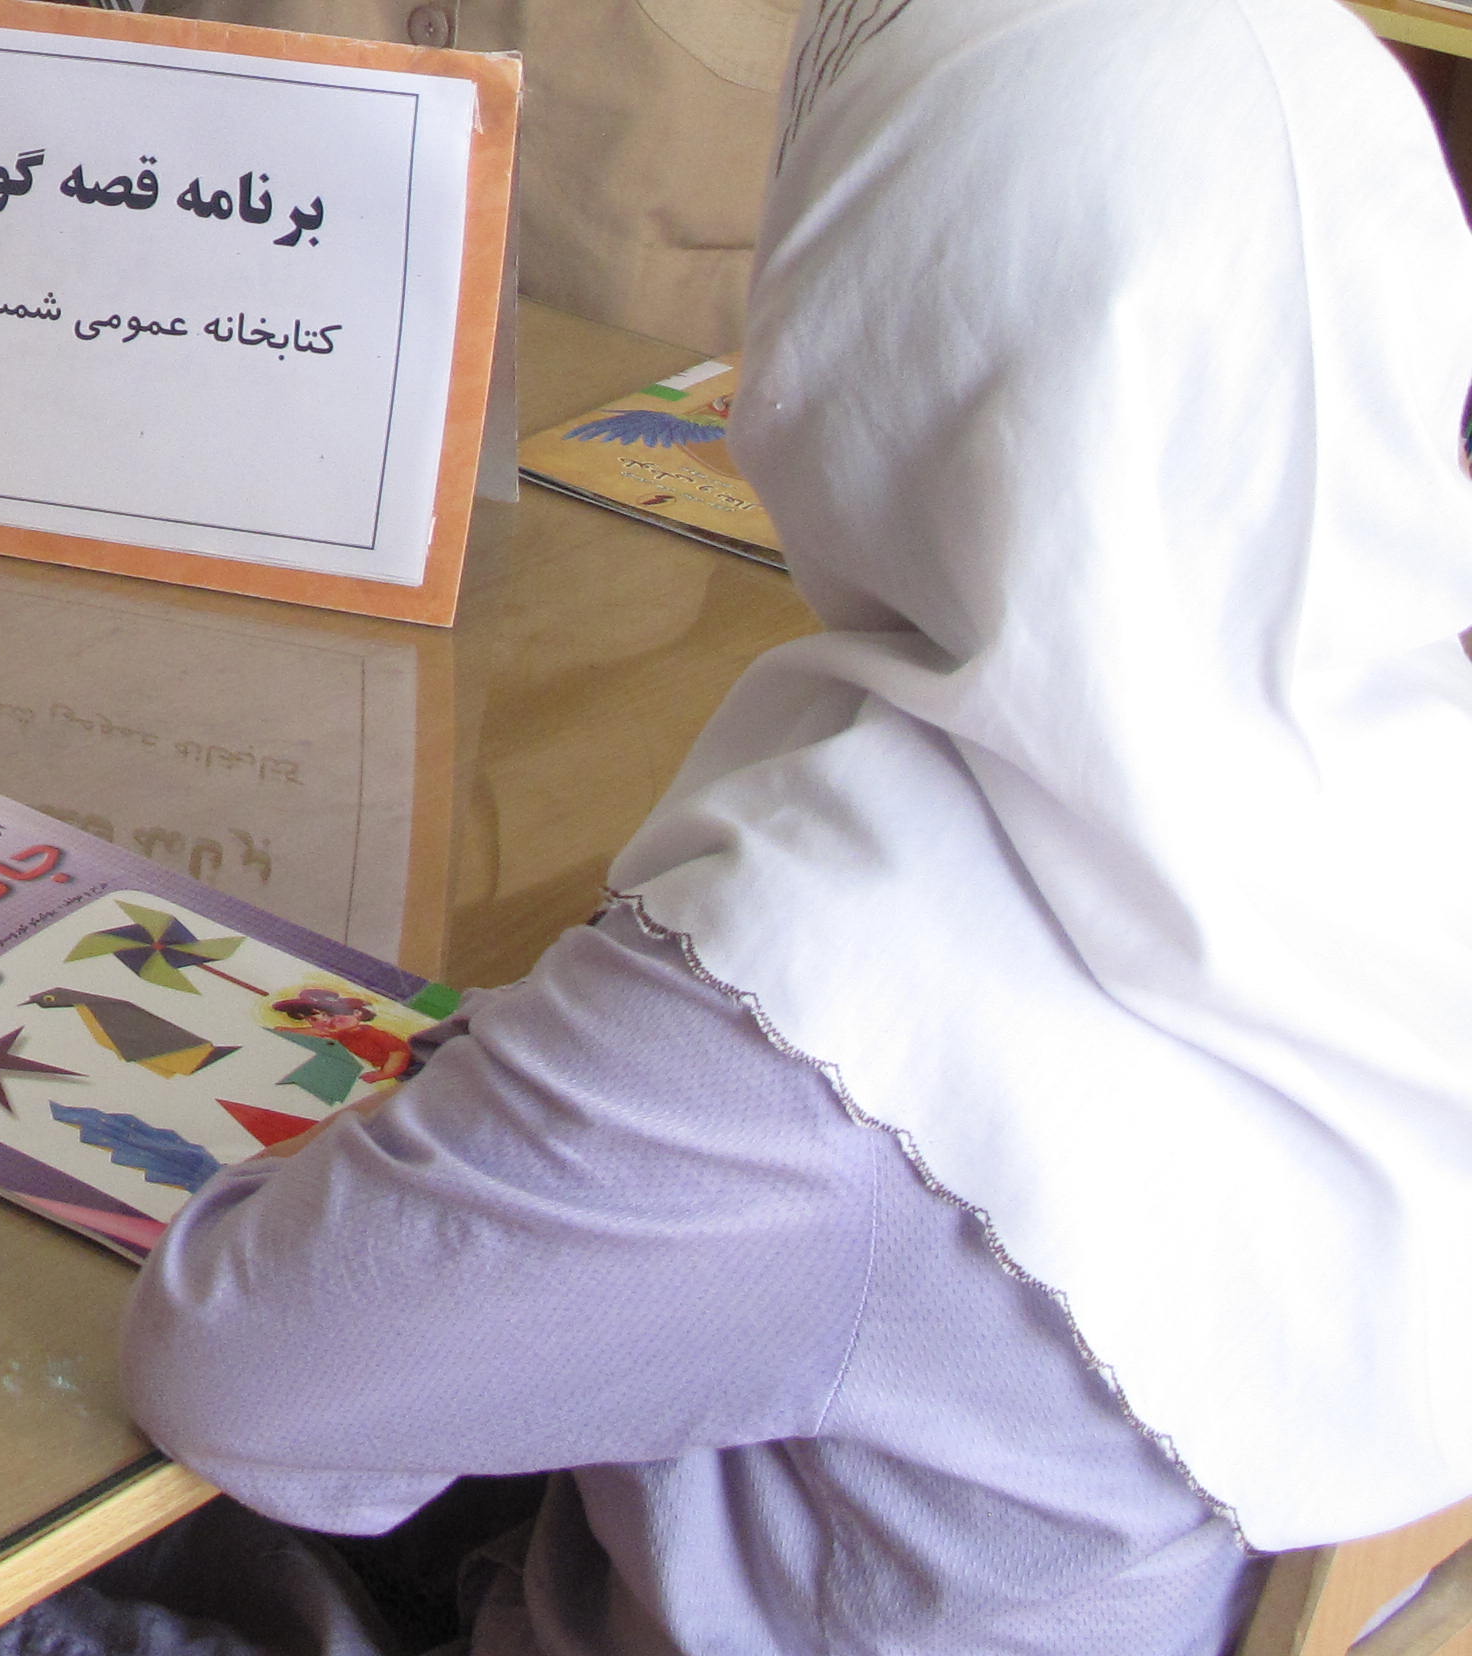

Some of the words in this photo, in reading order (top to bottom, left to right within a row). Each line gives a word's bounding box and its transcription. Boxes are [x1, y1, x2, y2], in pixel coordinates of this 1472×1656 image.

[59, 154, 159, 211] قصه
[177, 170, 325, 248] برنامه
[74, 312, 189, 344] عمومی
[204, 311, 343, 362] کتابخانه
